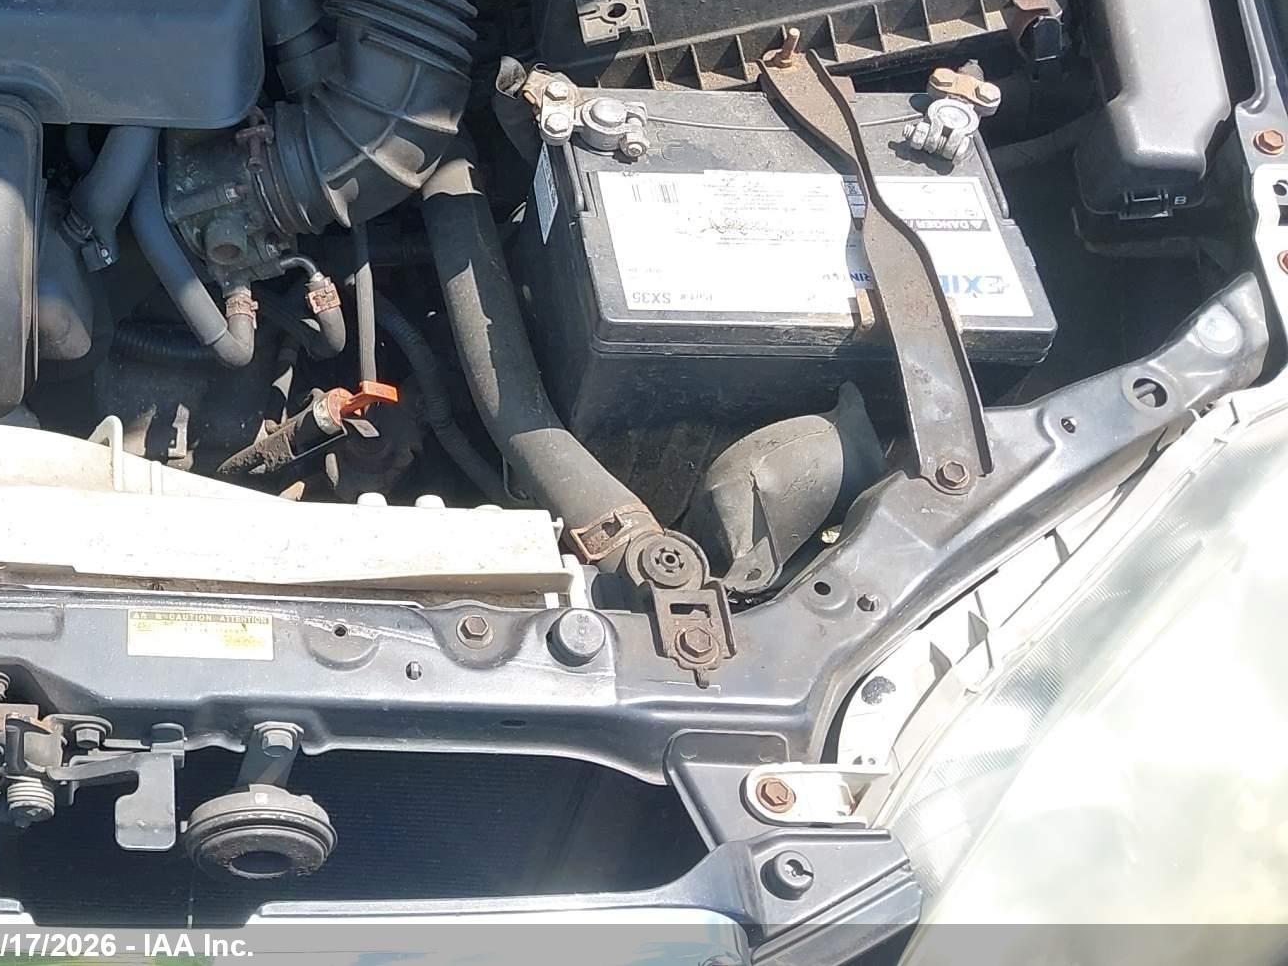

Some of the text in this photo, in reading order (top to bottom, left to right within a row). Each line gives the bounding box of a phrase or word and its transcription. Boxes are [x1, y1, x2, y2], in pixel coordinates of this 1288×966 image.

[915, 220, 970, 230] DANGER
[632, 291, 672, 304] SX35
[168, 613, 268, 625] CAUTION ATTENTION
